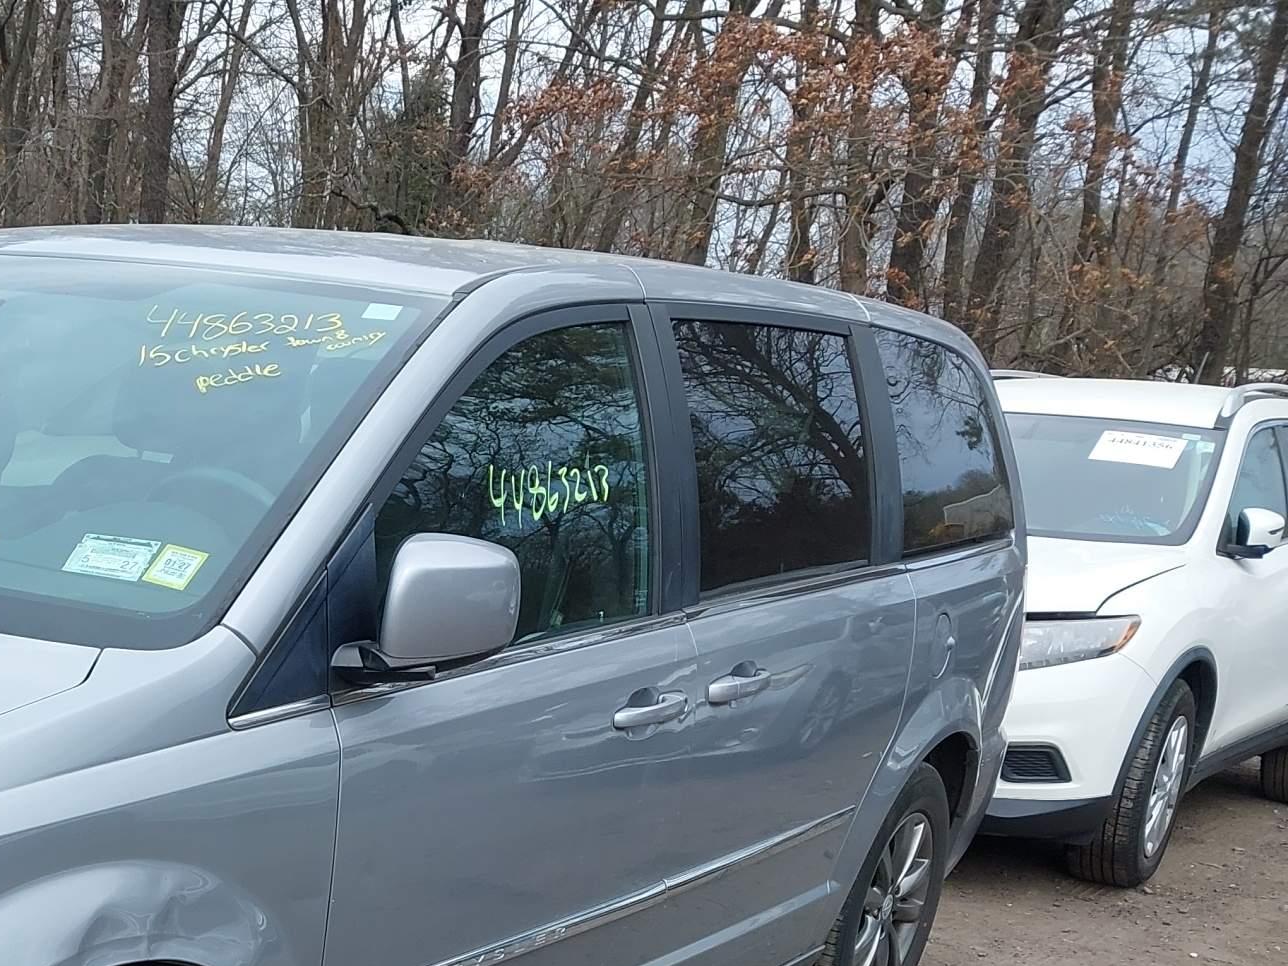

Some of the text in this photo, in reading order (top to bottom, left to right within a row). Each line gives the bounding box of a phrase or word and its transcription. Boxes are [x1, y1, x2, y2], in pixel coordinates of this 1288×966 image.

[146, 304, 343, 341] 44863213
[196, 363, 281, 393] peddle
[489, 460, 609, 529] 44863213
